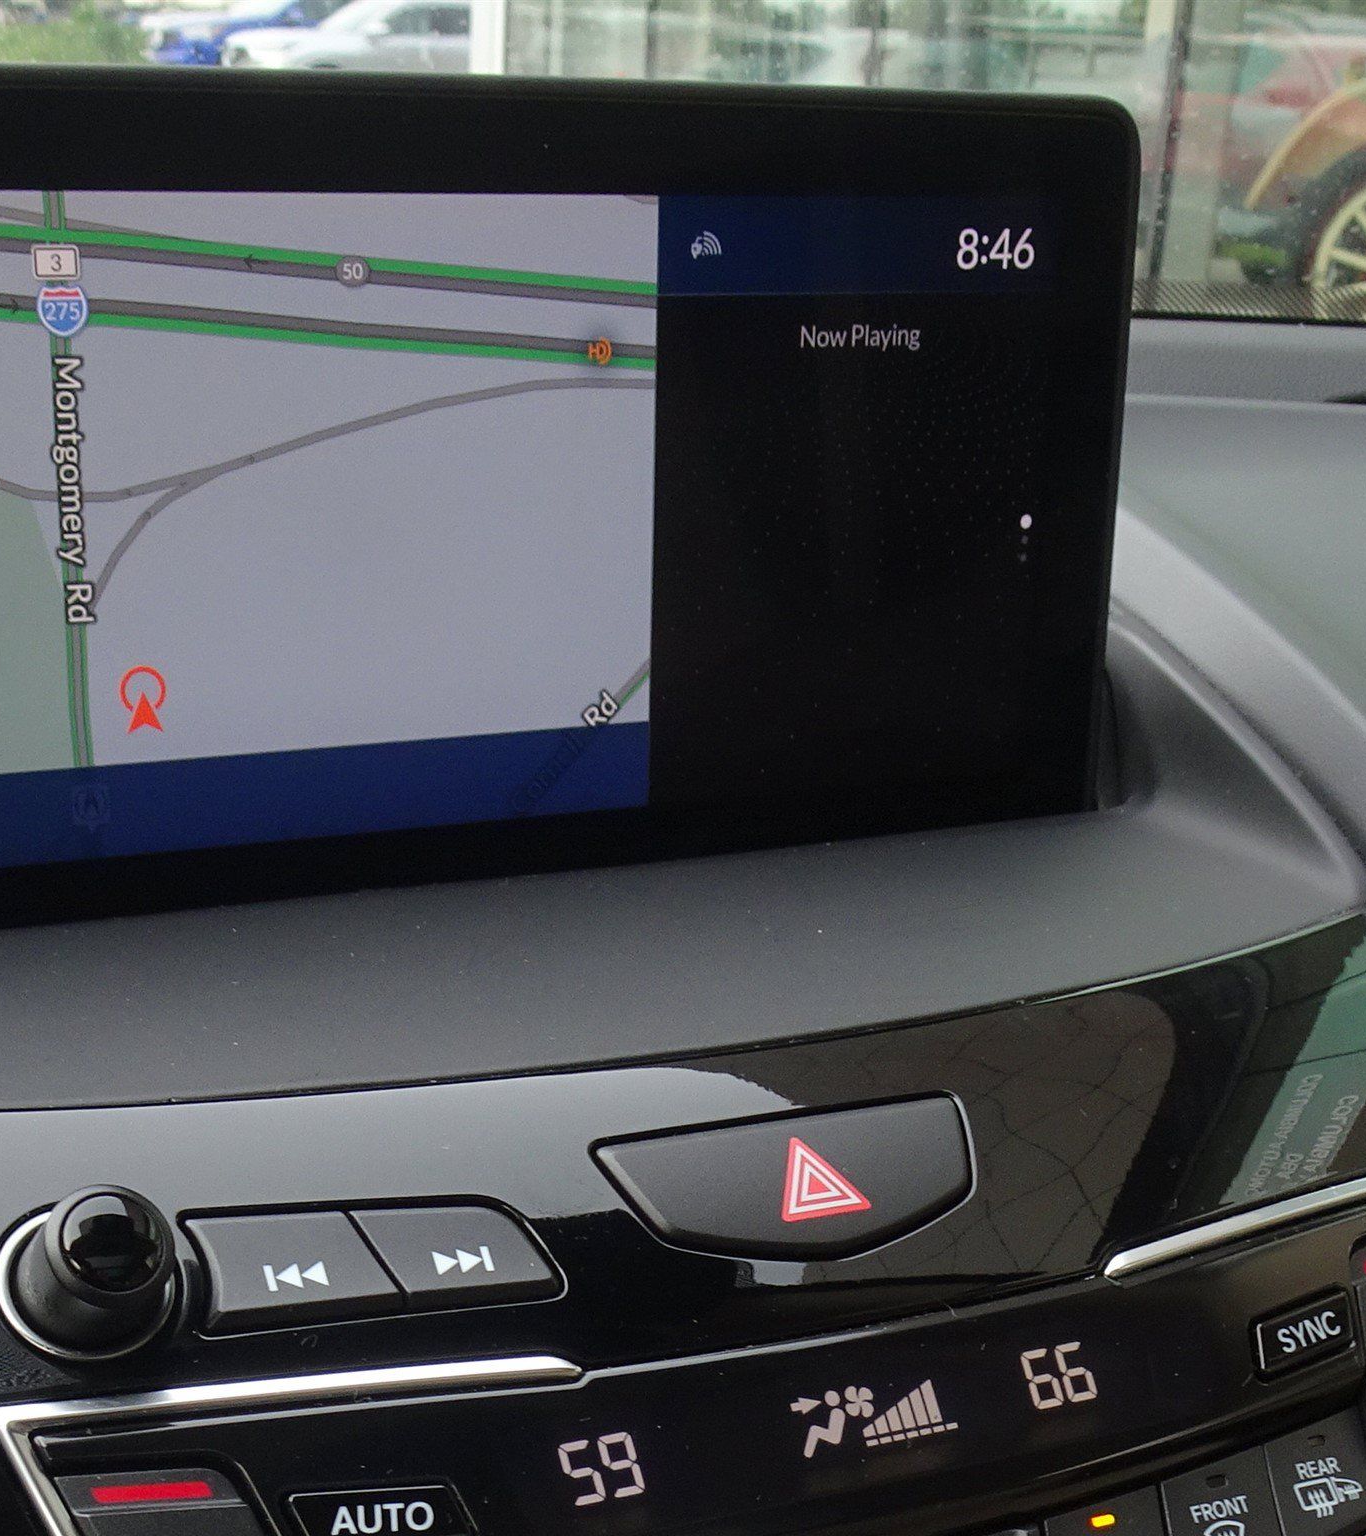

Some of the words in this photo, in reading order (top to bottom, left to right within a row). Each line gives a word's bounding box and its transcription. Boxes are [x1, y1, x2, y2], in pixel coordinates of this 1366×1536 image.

[50, 252, 62, 272] 3
[955, 227, 1035, 271] 8:46
[341, 262, 364, 281] 50
[43, 301, 81, 321] 275
[799, 325, 847, 350] Now
[851, 322, 921, 352] Playing
[51, 356, 85, 566] Montgomery
[65, 583, 96, 623] Rd
[583, 690, 618, 727] Rd
[1276, 1310, 1342, 1354] SYNC
[1020, 1341, 1098, 1410] 66
[557, 1431, 646, 1507] 59
[1294, 1456, 1341, 1480] REAR
[330, 1500, 435, 1536] AUTO
[1189, 1494, 1250, 1525] FRONT
